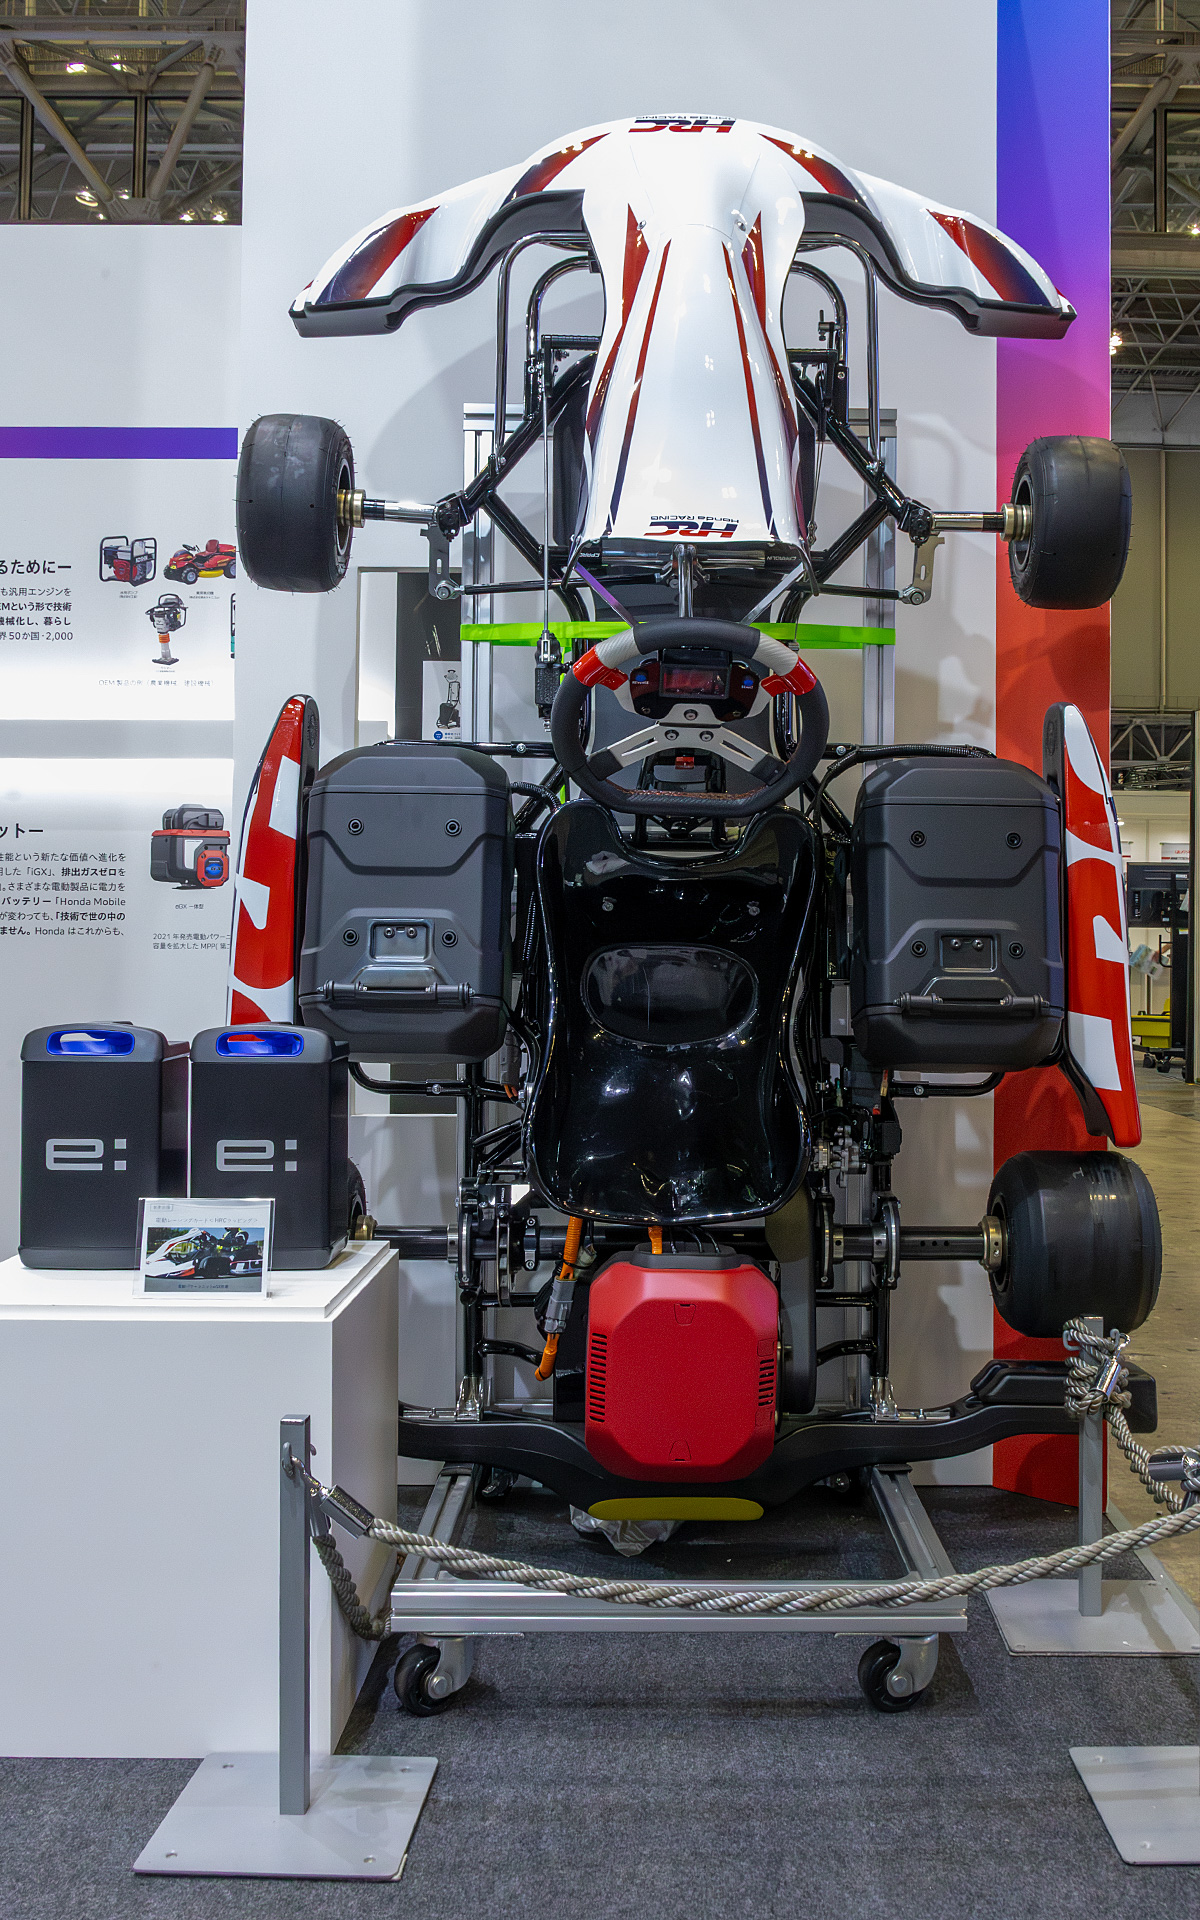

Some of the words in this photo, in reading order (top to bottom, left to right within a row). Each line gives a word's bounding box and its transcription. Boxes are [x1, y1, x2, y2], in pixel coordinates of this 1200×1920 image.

[628, 120, 736, 133] HRC
[697, 515, 739, 524] Honda
[643, 520, 738, 538] HRC
[0, 602, 72, 612] Mという形で技術
[0, 882, 126, 892] 。さまざまな電動製品に電力を
[93, 897, 126, 907] Mobile
[45, 1138, 127, 1171] e:
[216, 1139, 297, 1172] e:
